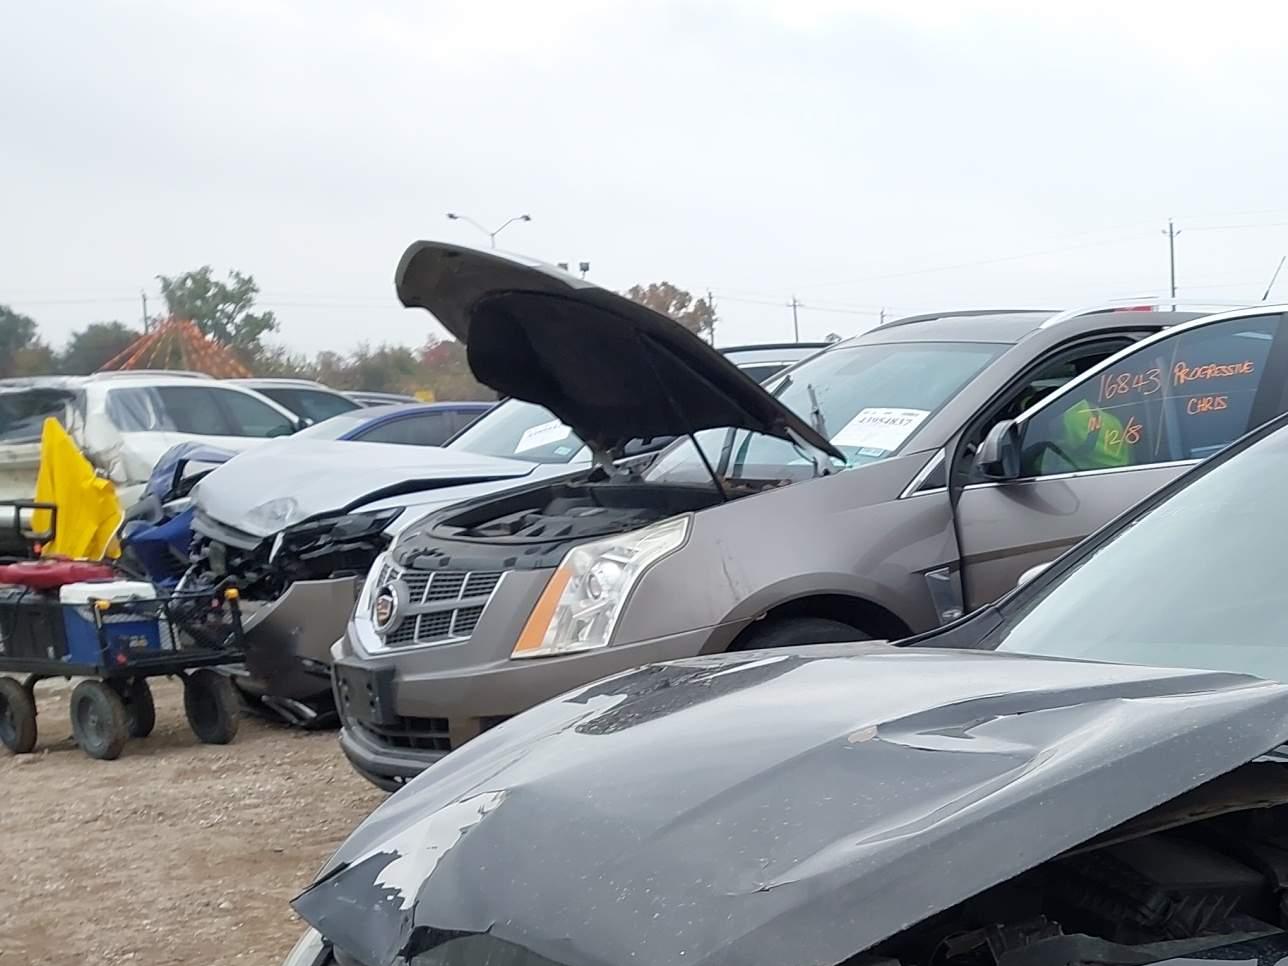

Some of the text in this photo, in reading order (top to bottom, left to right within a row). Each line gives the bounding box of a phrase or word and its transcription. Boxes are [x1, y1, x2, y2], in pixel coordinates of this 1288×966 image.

[1098, 368, 1161, 402] 16843
[1186, 396, 1228, 415] CHRIS
[1103, 416, 1142, 452] 12/8
